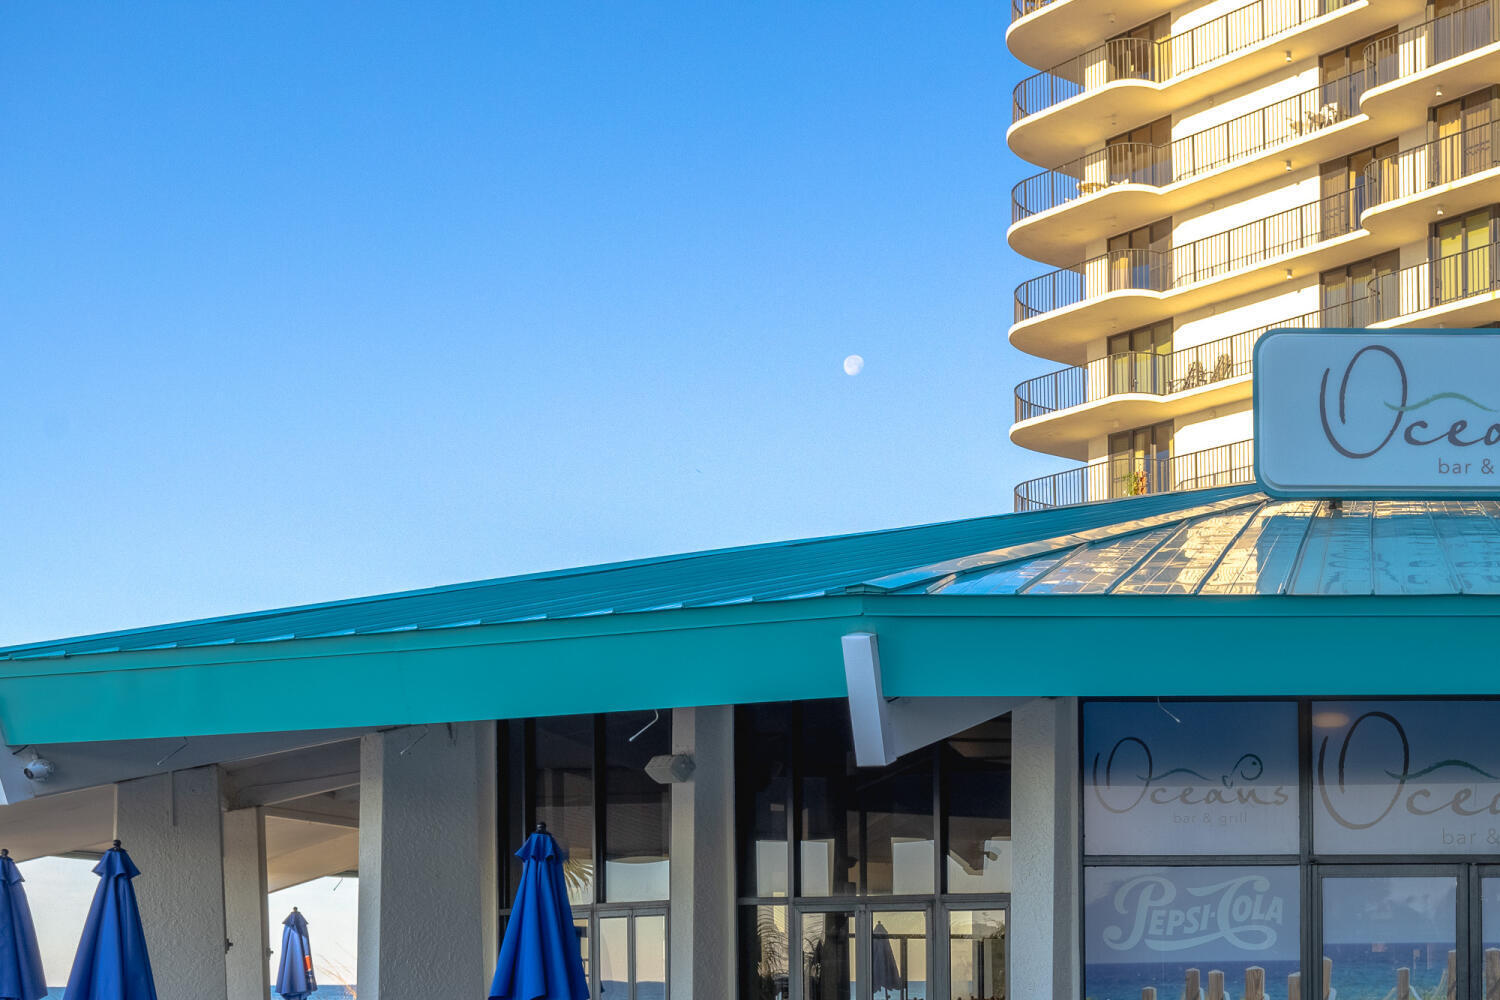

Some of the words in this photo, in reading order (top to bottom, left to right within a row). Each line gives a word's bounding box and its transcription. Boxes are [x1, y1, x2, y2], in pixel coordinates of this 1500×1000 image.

[1438, 458, 1471, 475] bar
[1481, 458, 1495, 475] &
[1093, 737, 1289, 814] Oceans
[1173, 813, 1196, 824] bar
[1202, 813, 1211, 824] &
[1220, 813, 1248, 826] grill
[1441, 828, 1477, 845] bar
[1486, 828, 1500, 845] &
